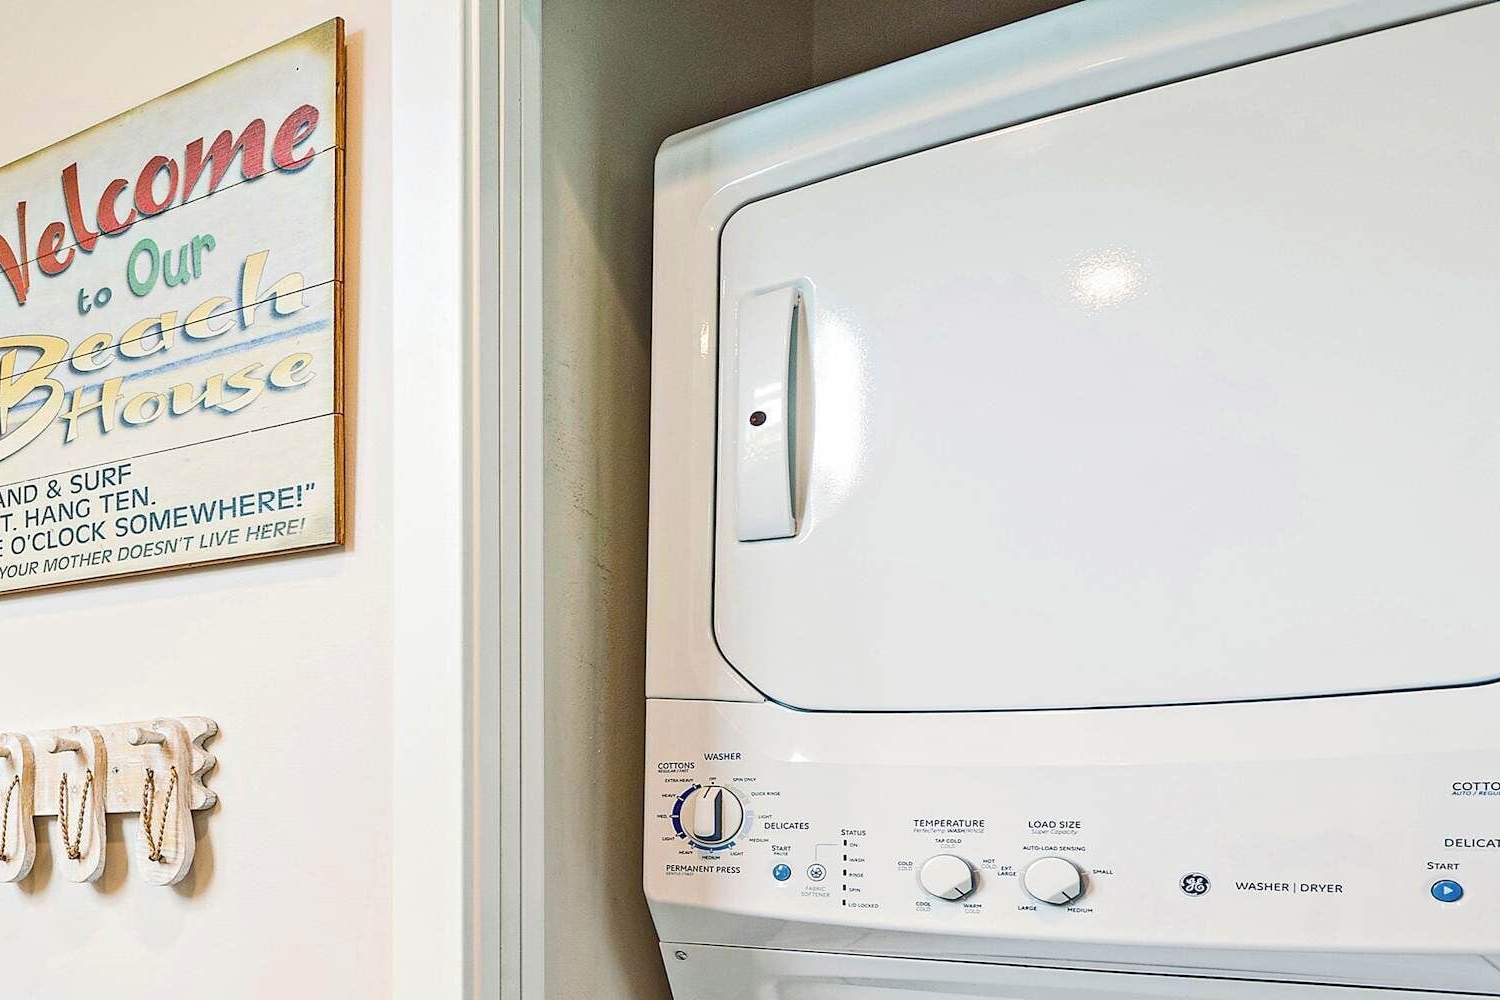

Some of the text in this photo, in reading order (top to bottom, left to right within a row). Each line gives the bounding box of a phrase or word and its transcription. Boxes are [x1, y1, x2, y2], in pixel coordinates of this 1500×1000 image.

[78, 231, 217, 315] to Our
[61, 350, 316, 445] House
[46, 479, 62, 498] &
[70, 463, 132, 494] SURF
[25, 499, 90, 528] HANG
[99, 486, 156, 513] TEN.
[0, 560, 39, 580] YOUR
[43, 549, 113, 573] MOTHER
[117, 536, 194, 562] DOESN'T
[199, 528, 240, 549] LIVE
[245, 517, 306, 542] HERE!
[11, 521, 106, 555] O'CLOCK
[704, 752, 742, 760] WASHER
[1452, 782, 1500, 790] COTTO
[1235, 882, 1289, 892] WASHER
[1300, 884, 1343, 893] DRYER
